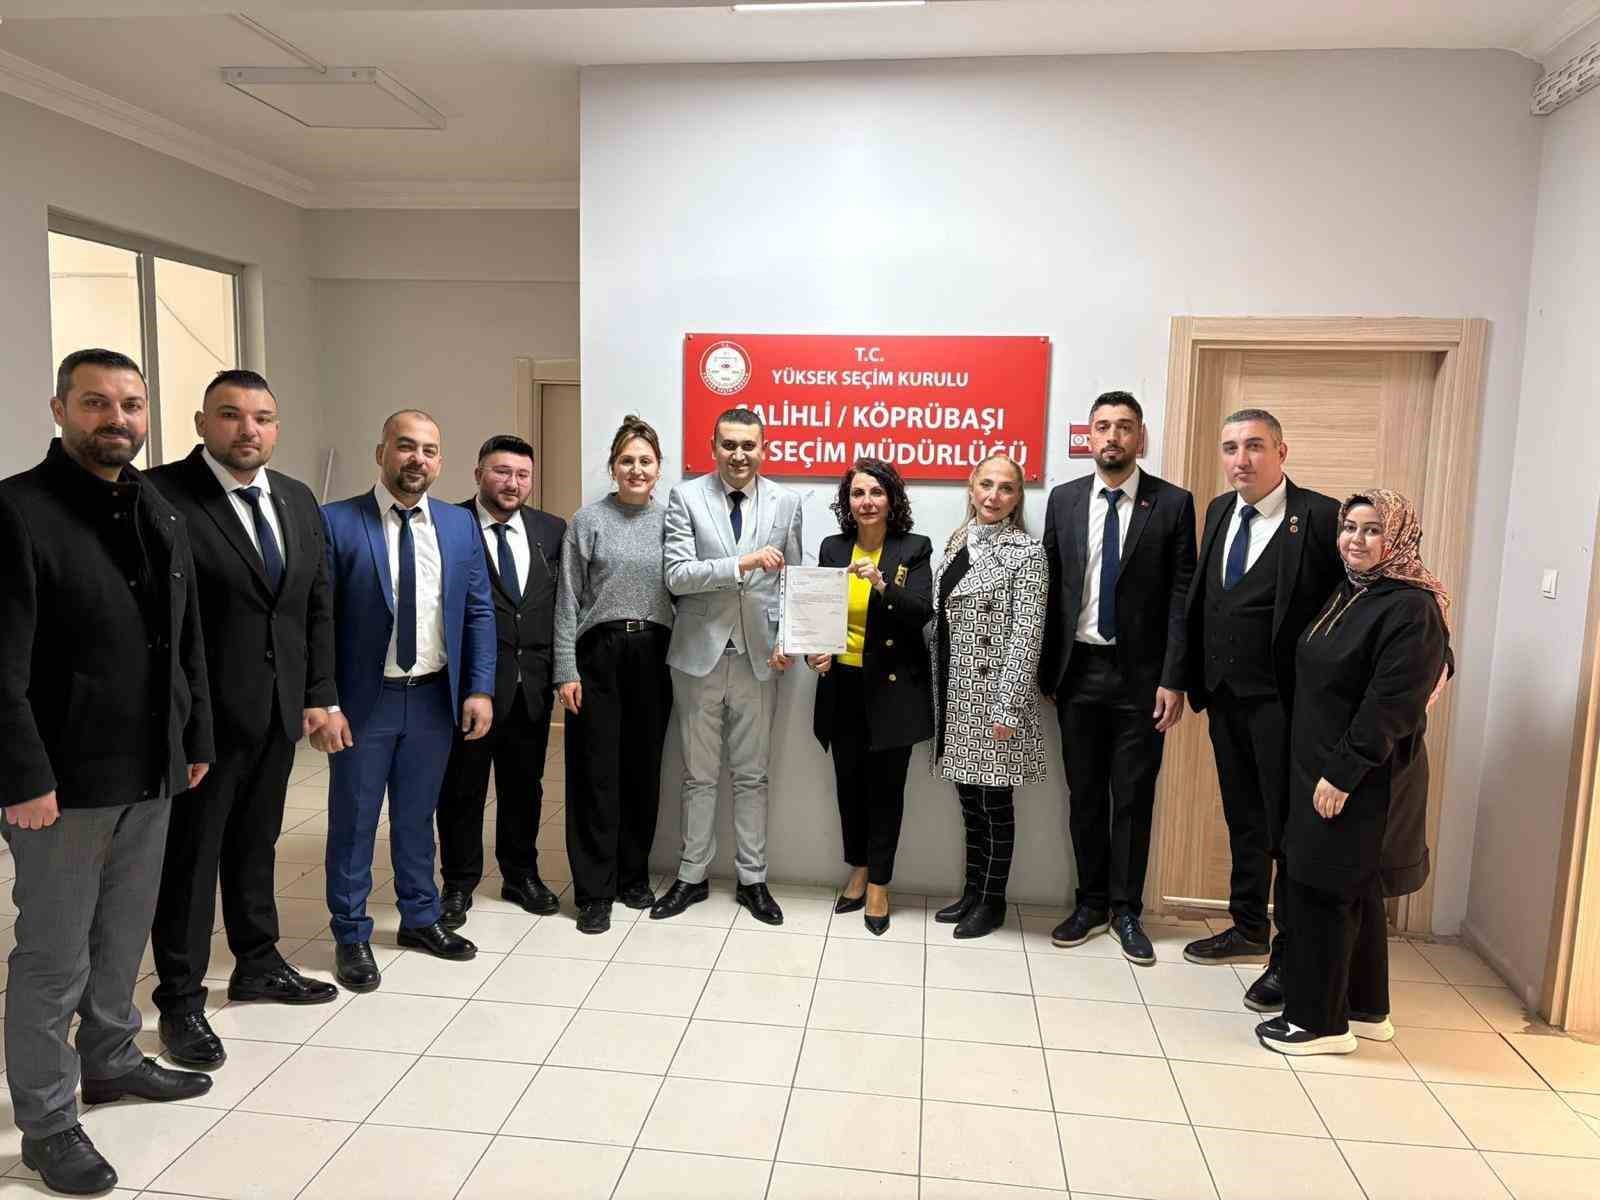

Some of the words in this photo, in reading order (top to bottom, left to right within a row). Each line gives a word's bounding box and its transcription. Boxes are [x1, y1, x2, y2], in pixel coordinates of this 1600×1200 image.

[854, 347, 884, 362] T.C.
[772, 367, 838, 385] YÜKSEK
[842, 368, 893, 389] SEÇİM
[898, 371, 969, 387] KURULU
[735, 400, 831, 427] ALİHLİ
[837, 405, 847, 428] /
[853, 401, 1005, 436] KÖPRÜBAŞI
[768, 437, 846, 468] SEÇİM
